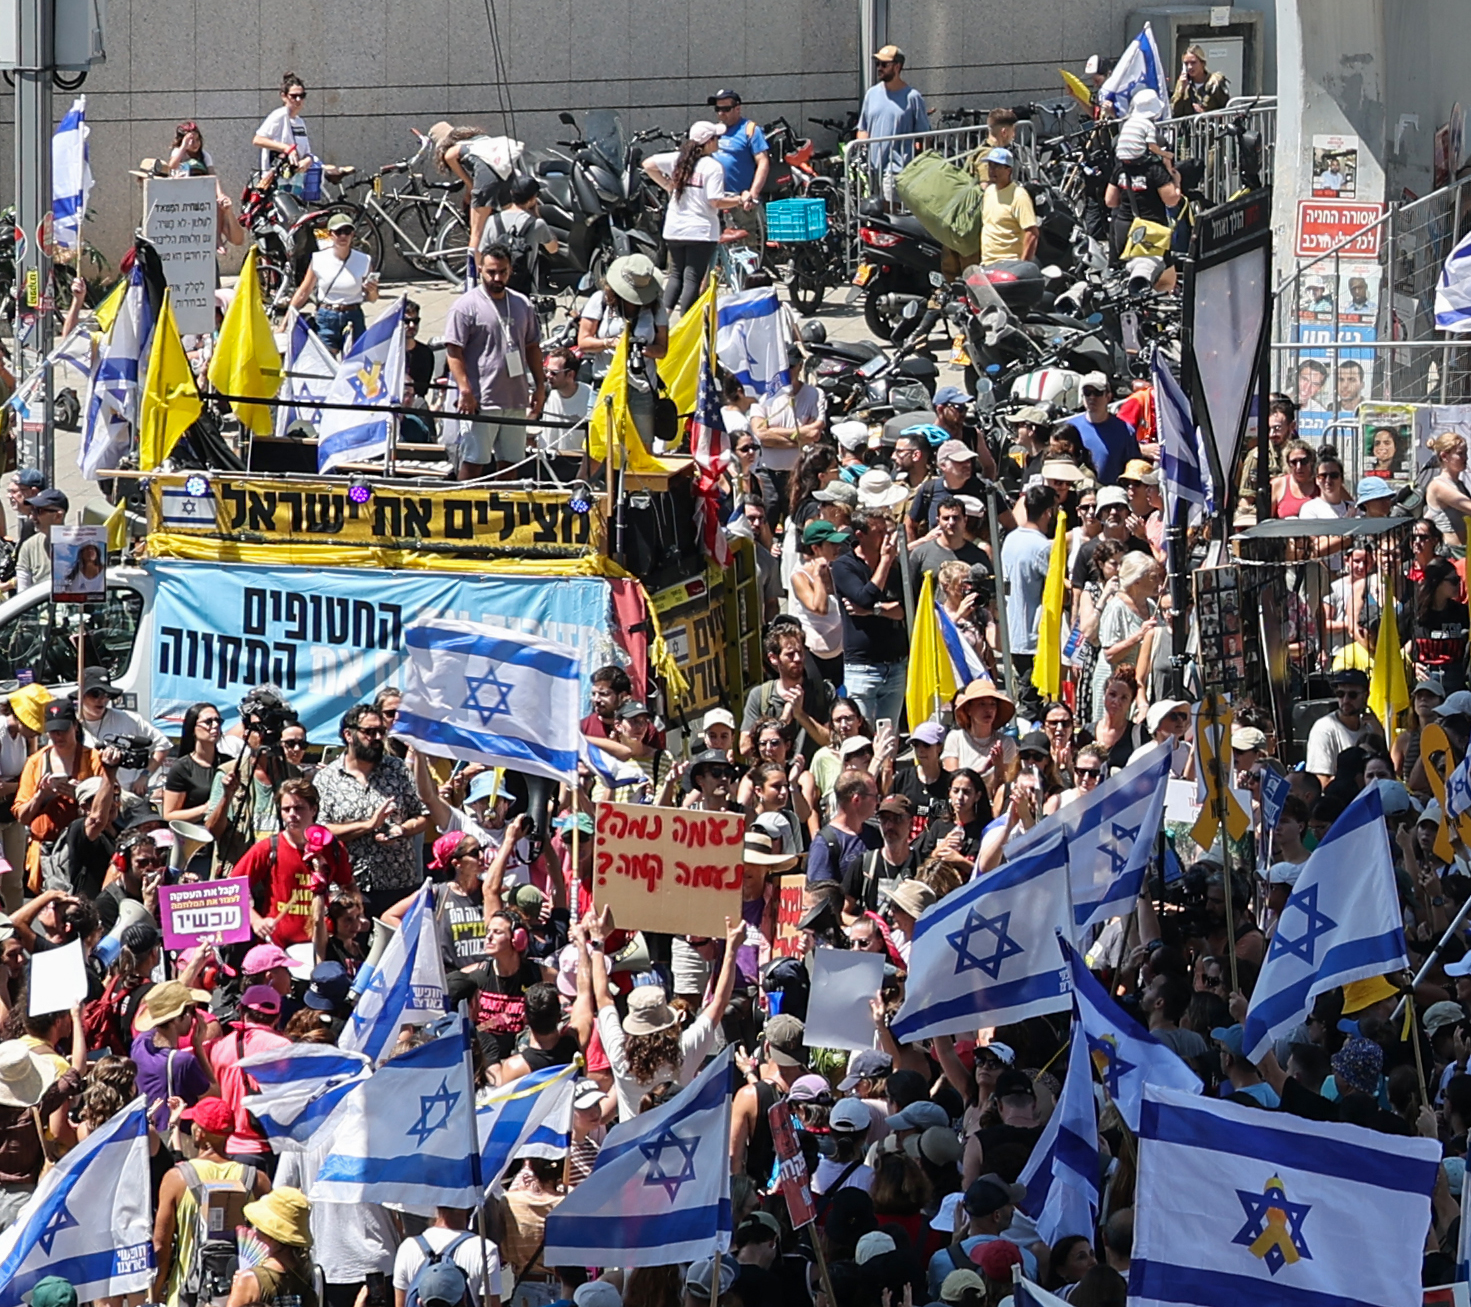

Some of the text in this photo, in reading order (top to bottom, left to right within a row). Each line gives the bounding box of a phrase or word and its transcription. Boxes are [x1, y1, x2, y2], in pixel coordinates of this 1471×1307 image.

[1306, 208, 1377, 227] אסורה החניה
[221, 482, 589, 544] מצילים את ישראל
[243, 586, 403, 652] החטופים
[158, 625, 298, 692] התקווה
[596, 802, 745, 849] נעמה נמה?
[597, 850, 745, 893] נעמה קמה?
[169, 884, 240, 906] לקבל את העסקה
[177, 908, 238, 930] עכשיו
[116, 1245, 147, 1262] חופשי
